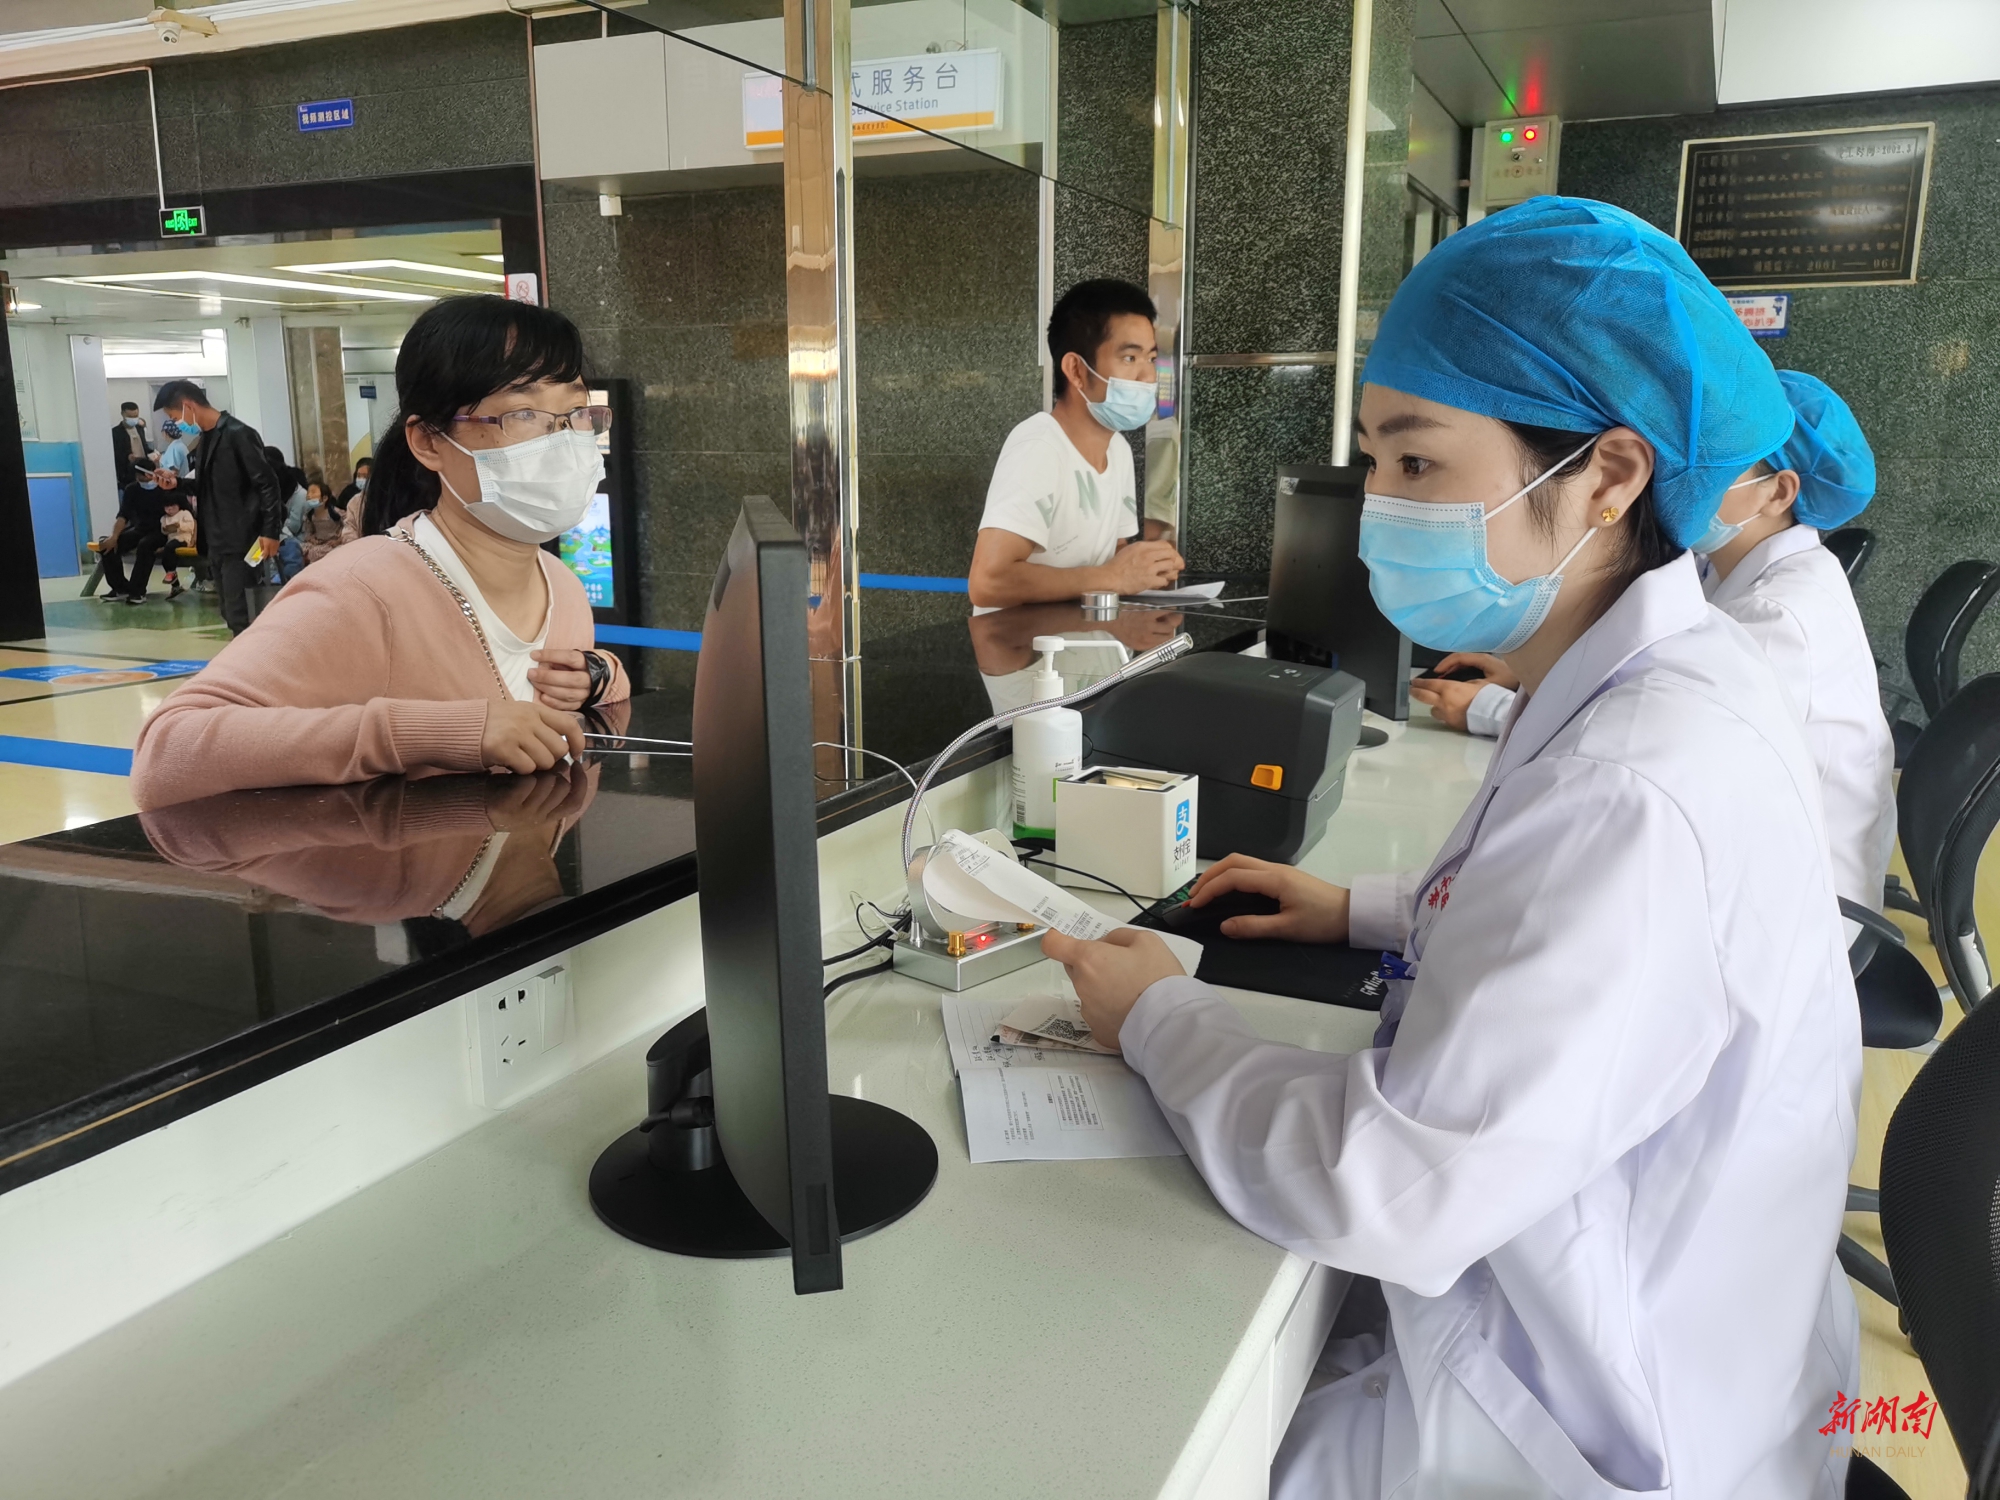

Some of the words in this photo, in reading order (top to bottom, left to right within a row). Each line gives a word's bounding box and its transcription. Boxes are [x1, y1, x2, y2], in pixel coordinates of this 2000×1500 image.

[895, 97, 938, 112] Station
[1173, 838, 1191, 864] 支付宝
